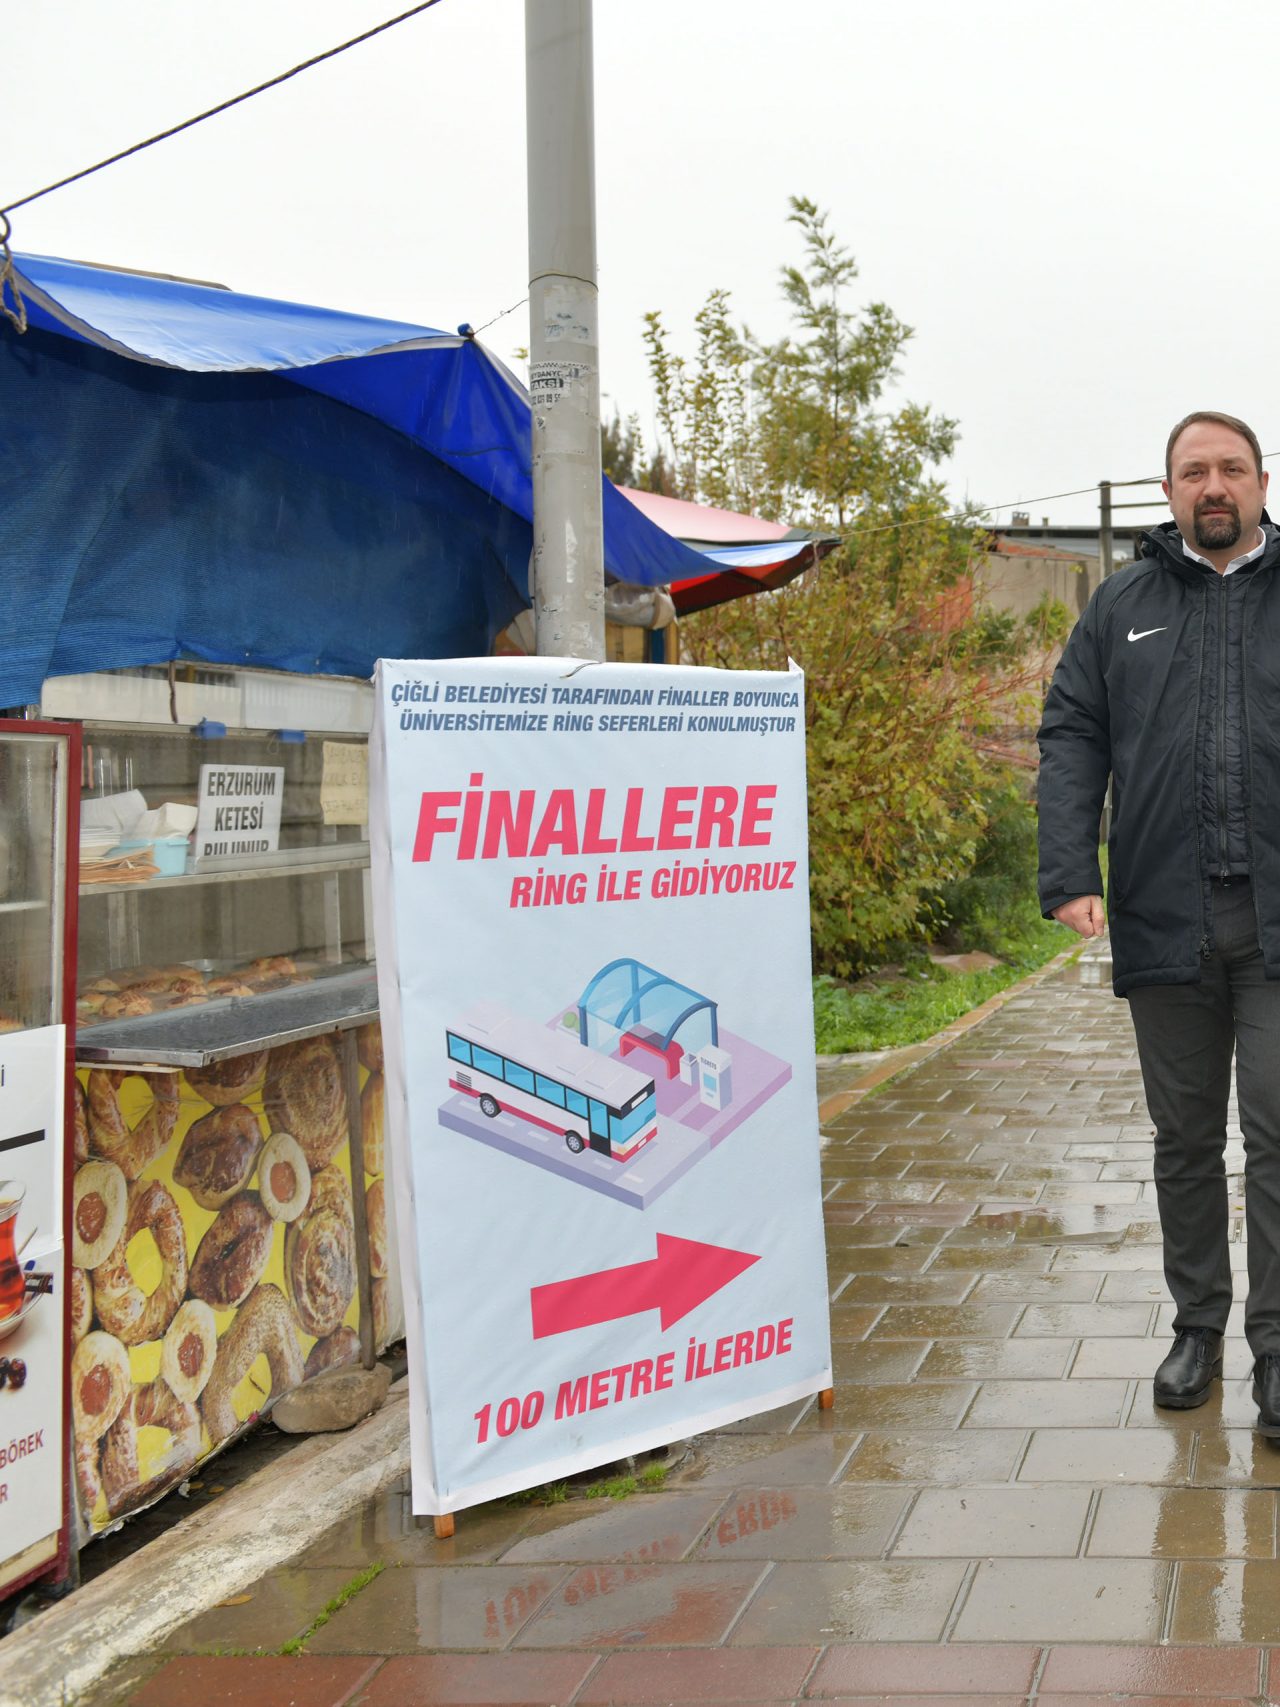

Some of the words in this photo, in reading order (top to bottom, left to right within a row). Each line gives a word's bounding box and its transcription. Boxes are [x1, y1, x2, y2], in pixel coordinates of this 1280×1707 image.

[391, 680, 440, 708] ÇİĞLİ
[444, 682, 547, 704] BELEDİYESİ
[552, 686, 652, 706] TARAFINDAN
[658, 686, 729, 707] FİNALLER
[732, 690, 799, 708] BOYUNCA
[399, 709, 548, 732] ÜNİVERSİTEMİZE
[552, 710, 594, 732] RİNG
[598, 711, 684, 732] SEFERLERİ
[687, 715, 796, 737] KONULMUŞTUR
[214, 801, 264, 832] KETESİ
[411, 772, 778, 863] FİNALLERE
[509, 866, 588, 908] RİNG
[596, 863, 643, 903] İLE
[650, 858, 797, 899] GİDİYORUZ
[473, 1390, 545, 1444] 100
[553, 1352, 675, 1421] METRE
[684, 1317, 794, 1382] İLERDE
